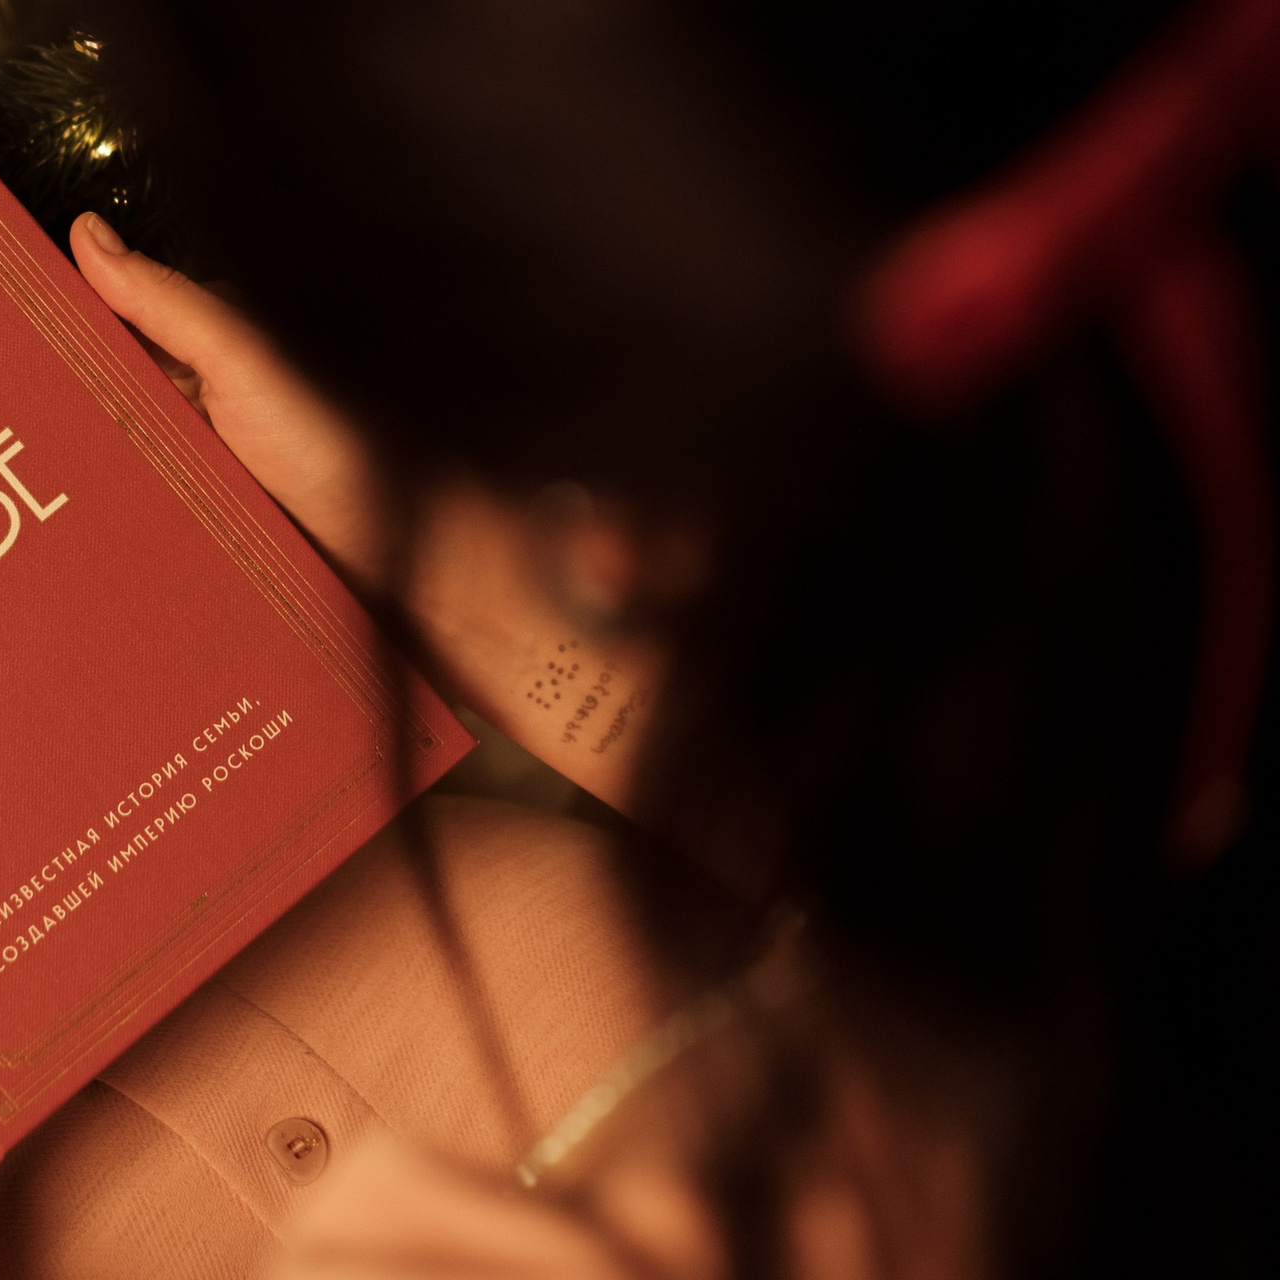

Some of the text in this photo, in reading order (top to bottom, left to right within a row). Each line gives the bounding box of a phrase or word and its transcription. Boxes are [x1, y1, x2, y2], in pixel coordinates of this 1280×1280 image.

[103, 753, 188, 829] ИСТОРИЯ
[192, 696, 261, 752] СЕМЬИ,
[107, 793, 197, 873] ИМПЕРИЮ
[202, 710, 294, 792] РОСКОШИ
